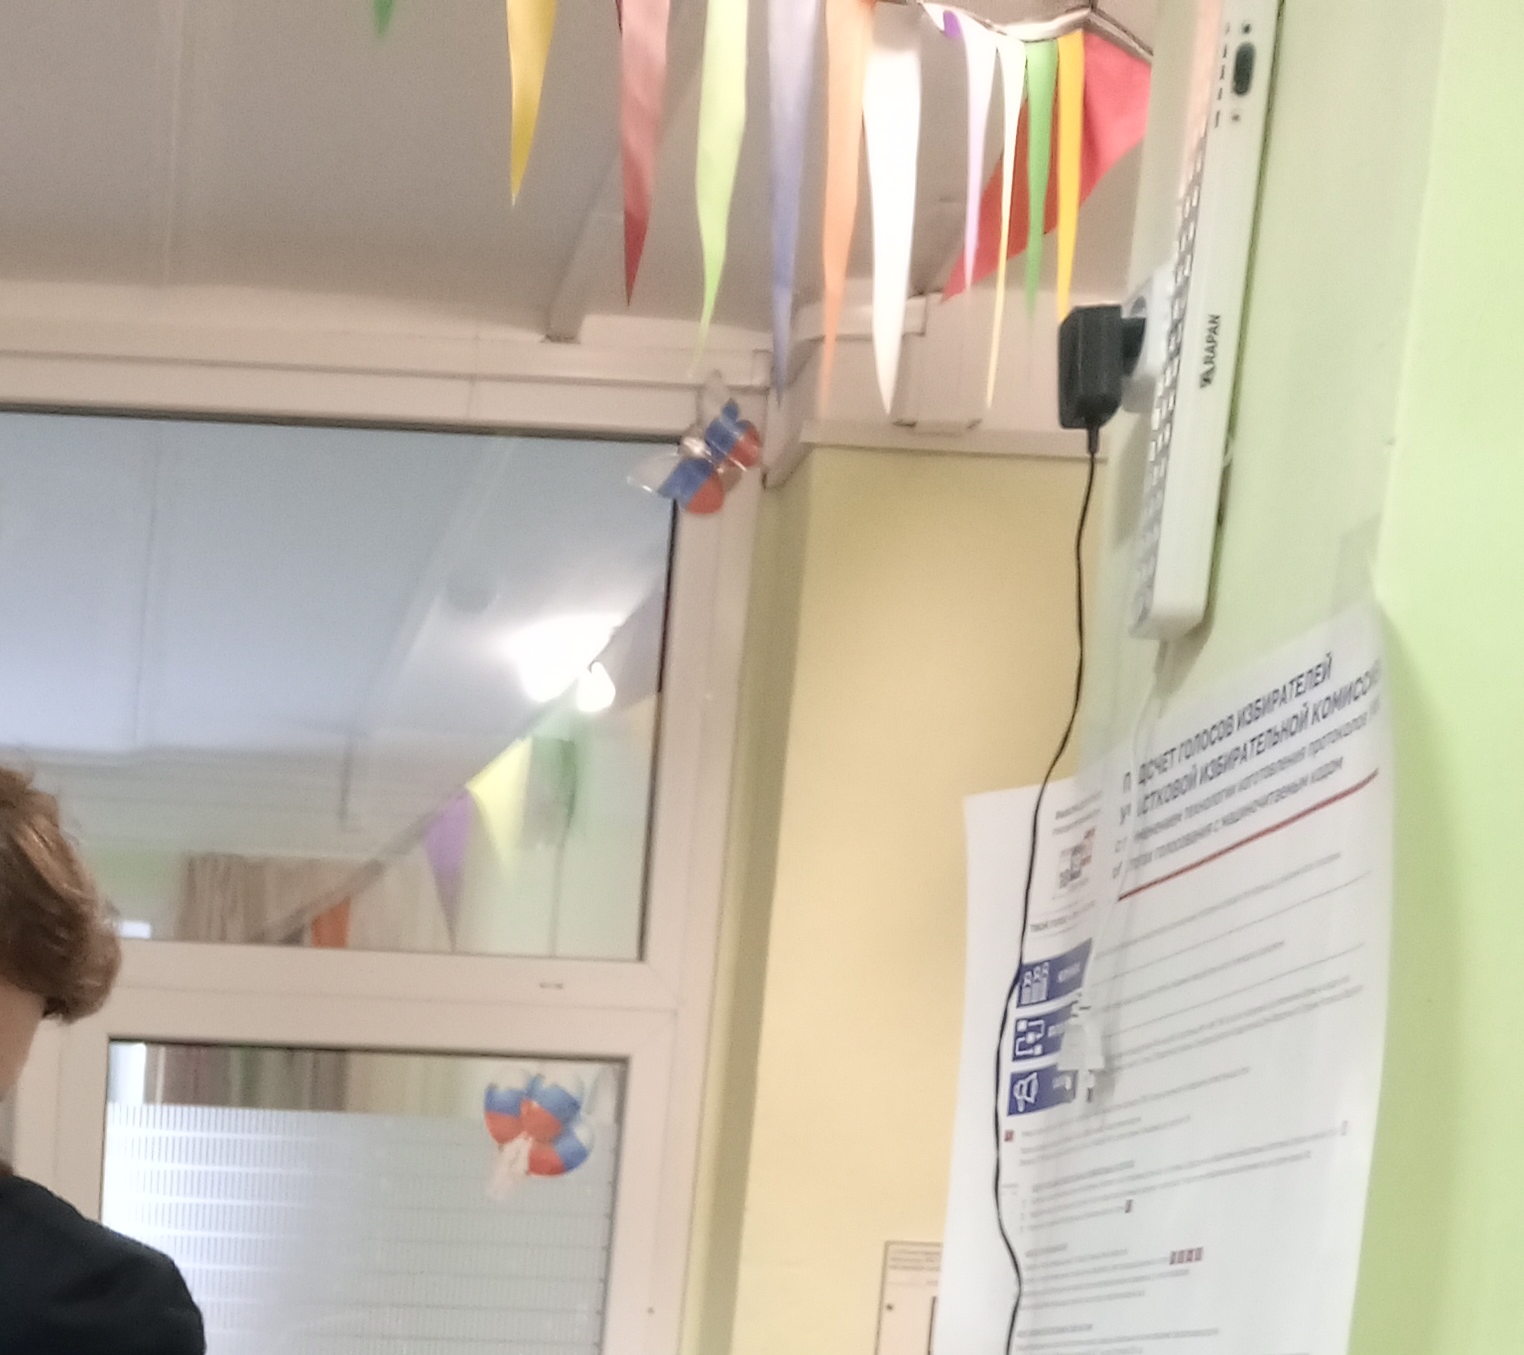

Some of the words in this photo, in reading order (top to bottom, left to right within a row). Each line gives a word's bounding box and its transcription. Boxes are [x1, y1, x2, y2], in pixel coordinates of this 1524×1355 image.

[1121, 747, 1177, 793] ПДСЧЕТ
[1177, 713, 1236, 764] ГОЛОСОВ
[1235, 651, 1333, 732] ИЗБИРАТЕЛЕЙ
[1198, 701, 1310, 786] ИЗБИРАТЕЛЬНОЙ
